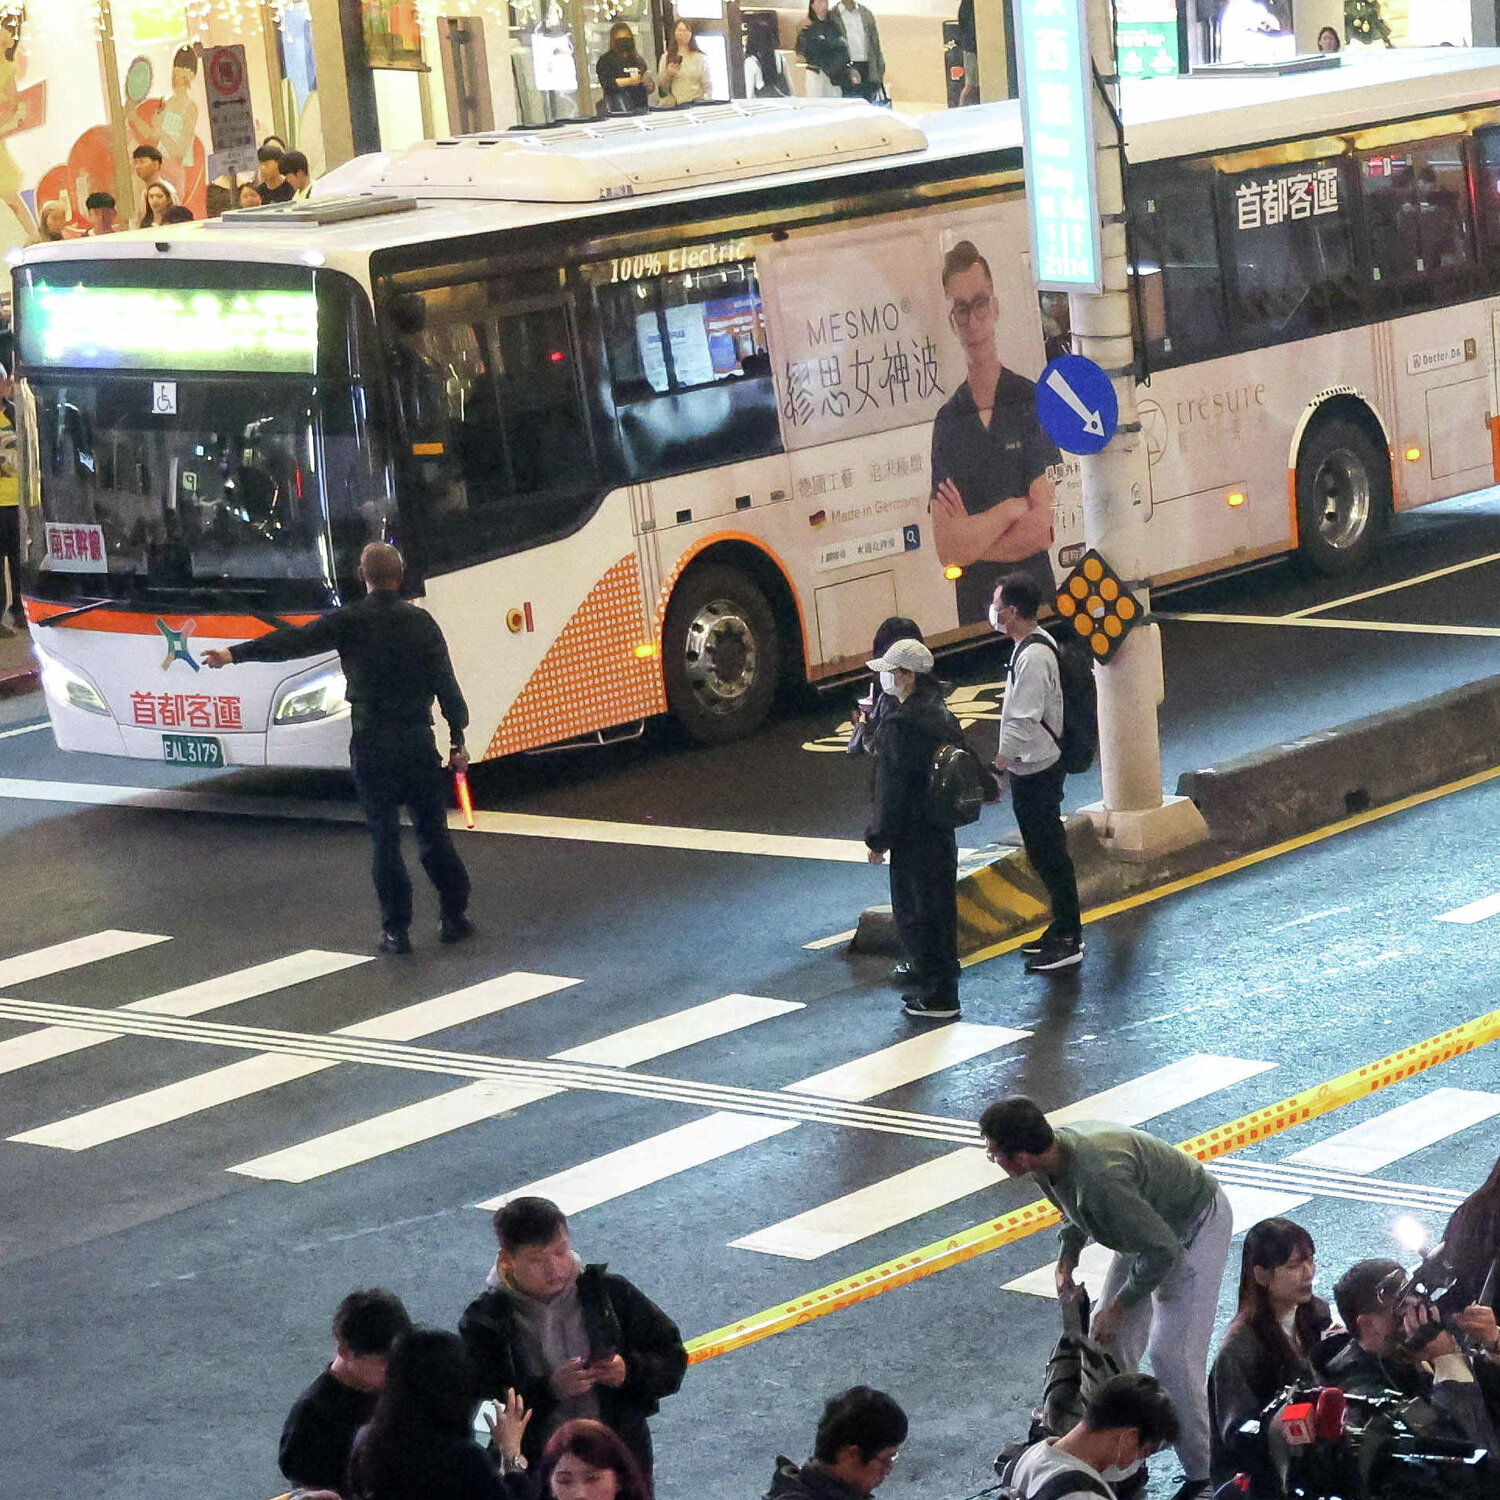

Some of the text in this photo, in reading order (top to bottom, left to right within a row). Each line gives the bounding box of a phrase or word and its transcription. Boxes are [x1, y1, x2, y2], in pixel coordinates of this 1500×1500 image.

[1235, 167, 1340, 230] 首都客運
[610, 241, 746, 284] 100% Electric
[807, 303, 899, 346] MESMO
[130, 690, 242, 729] 首都客運
